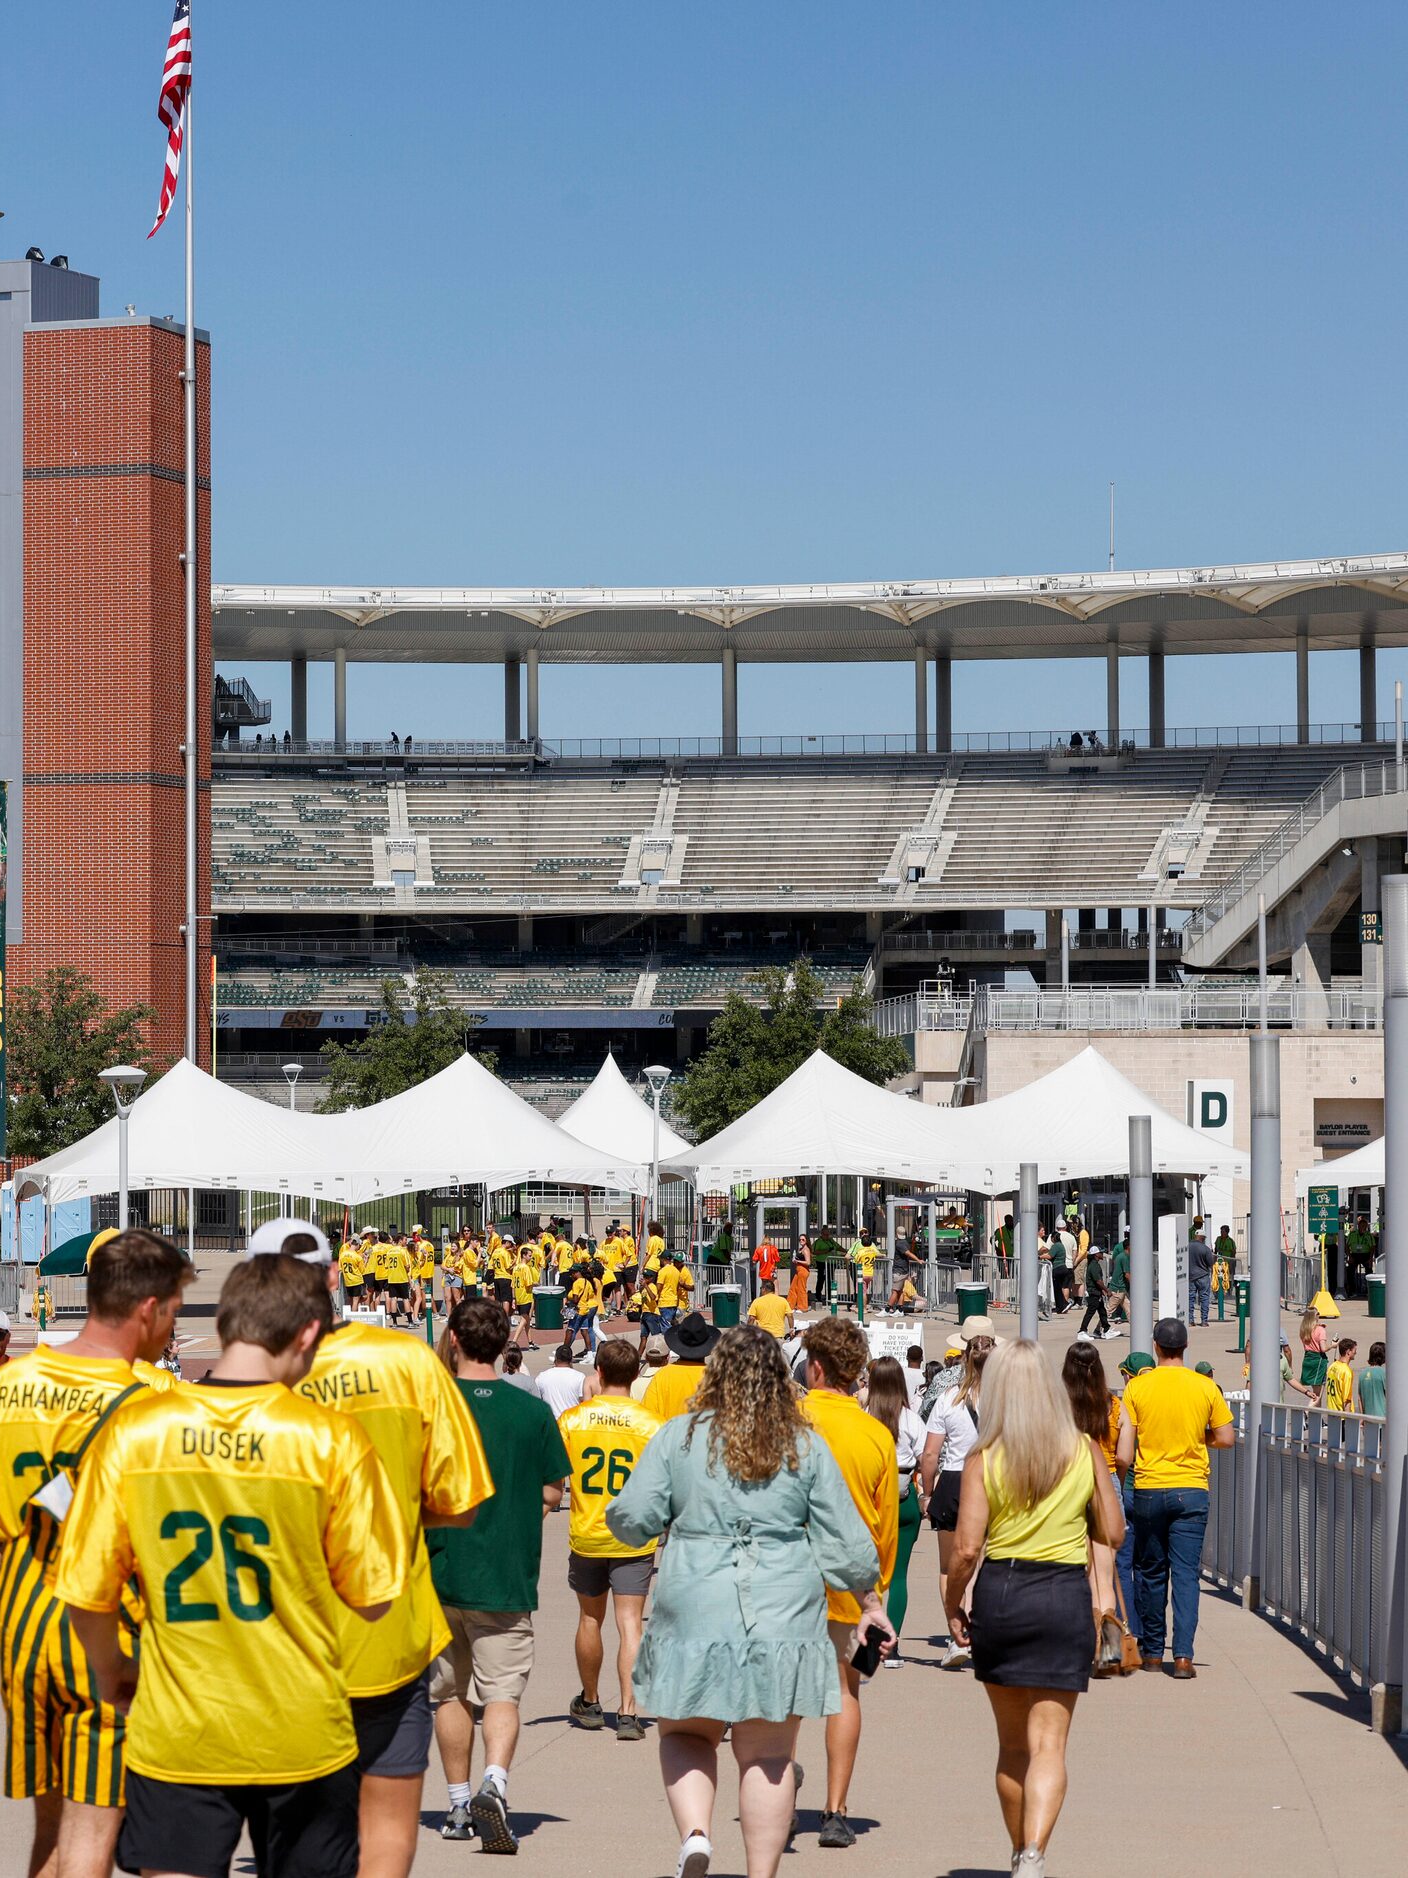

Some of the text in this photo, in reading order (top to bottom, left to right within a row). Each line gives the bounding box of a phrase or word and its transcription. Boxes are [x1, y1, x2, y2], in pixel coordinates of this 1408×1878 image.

[1362, 914, 1377, 925] 130
[1362, 929, 1376, 940] 131
[1201, 1091, 1227, 1128] D
[182, 1427, 266, 1462] DUSEK
[581, 1446, 634, 1496] 26
[160, 1510, 274, 1623] 26
